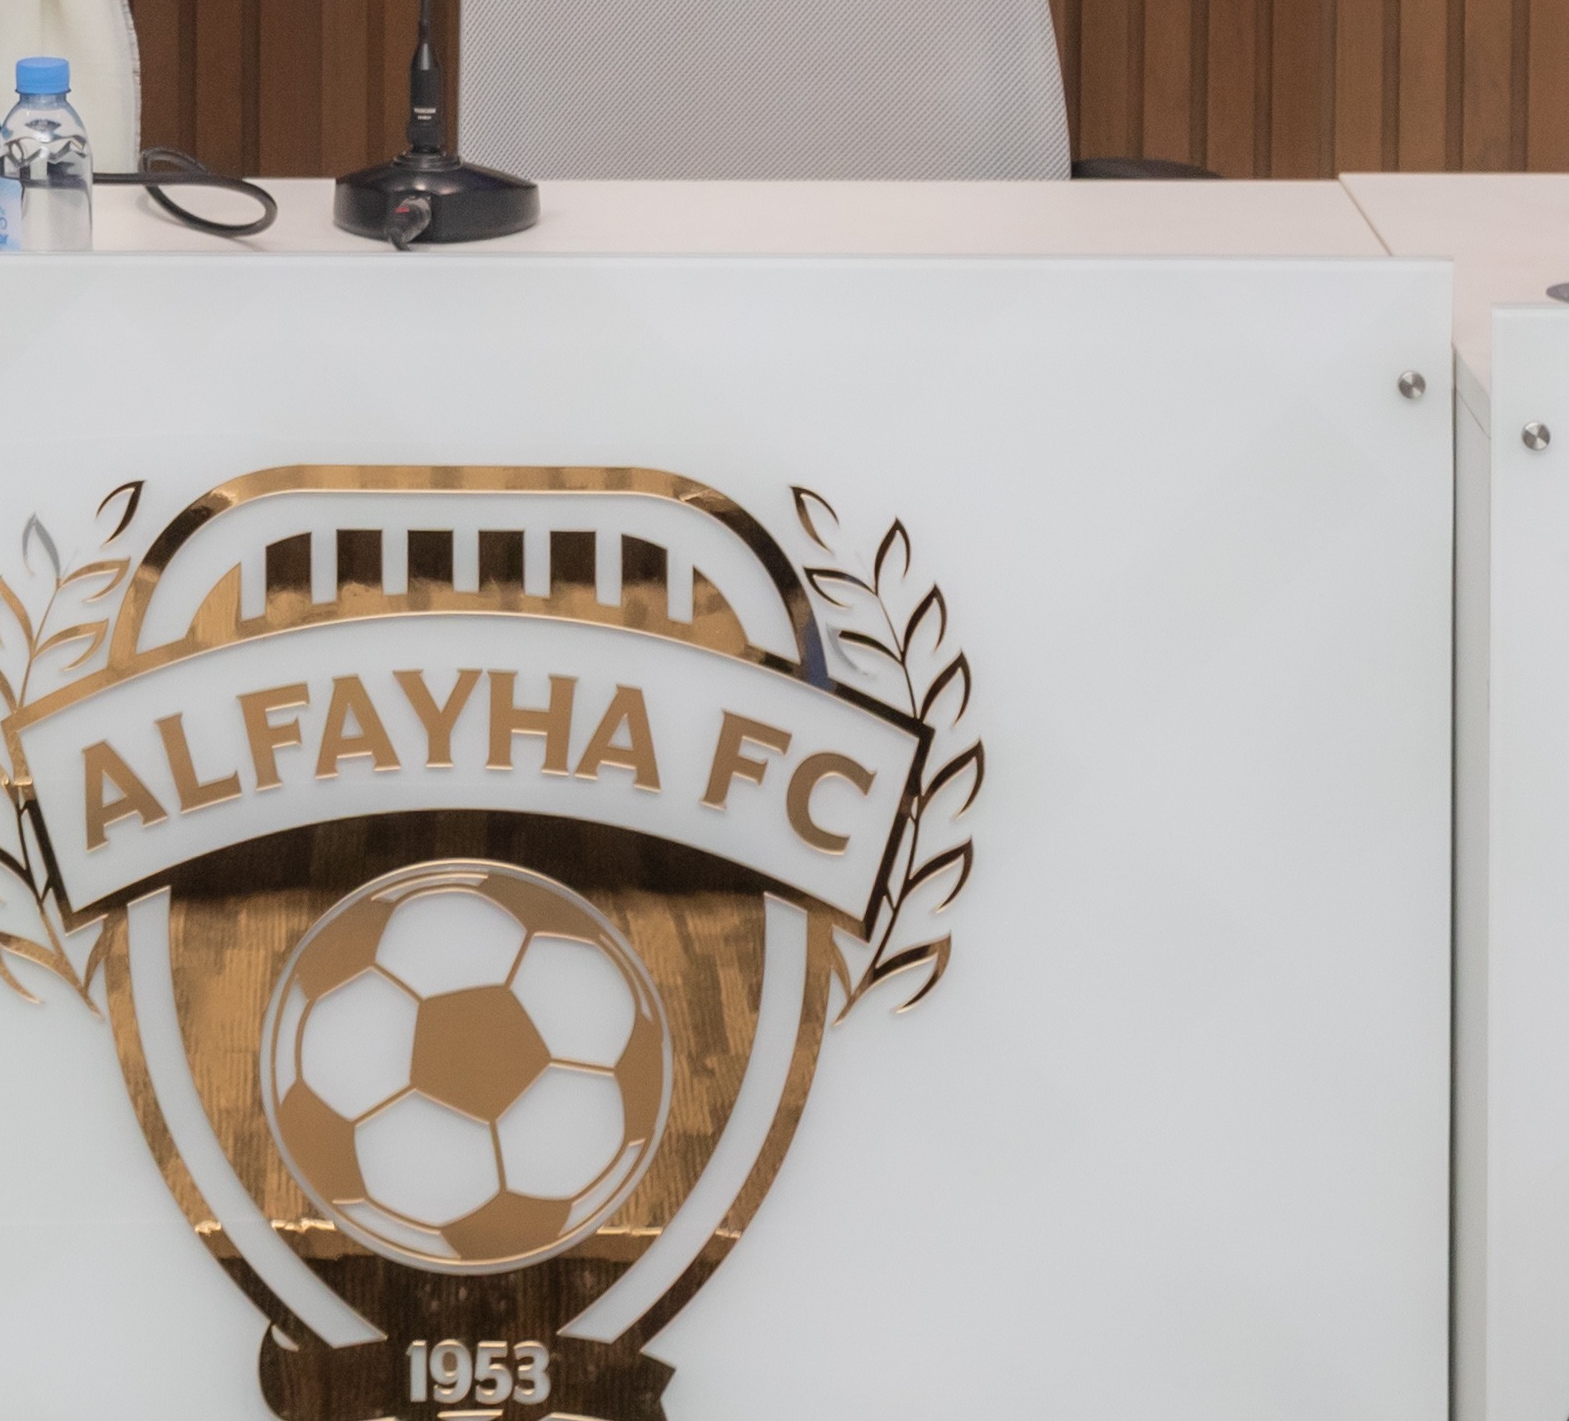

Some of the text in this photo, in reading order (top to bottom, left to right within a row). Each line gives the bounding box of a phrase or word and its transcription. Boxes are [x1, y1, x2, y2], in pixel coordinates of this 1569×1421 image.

[82, 668, 879, 857] ALFAYHA FC
[406, 1338, 551, 1405] 1953
